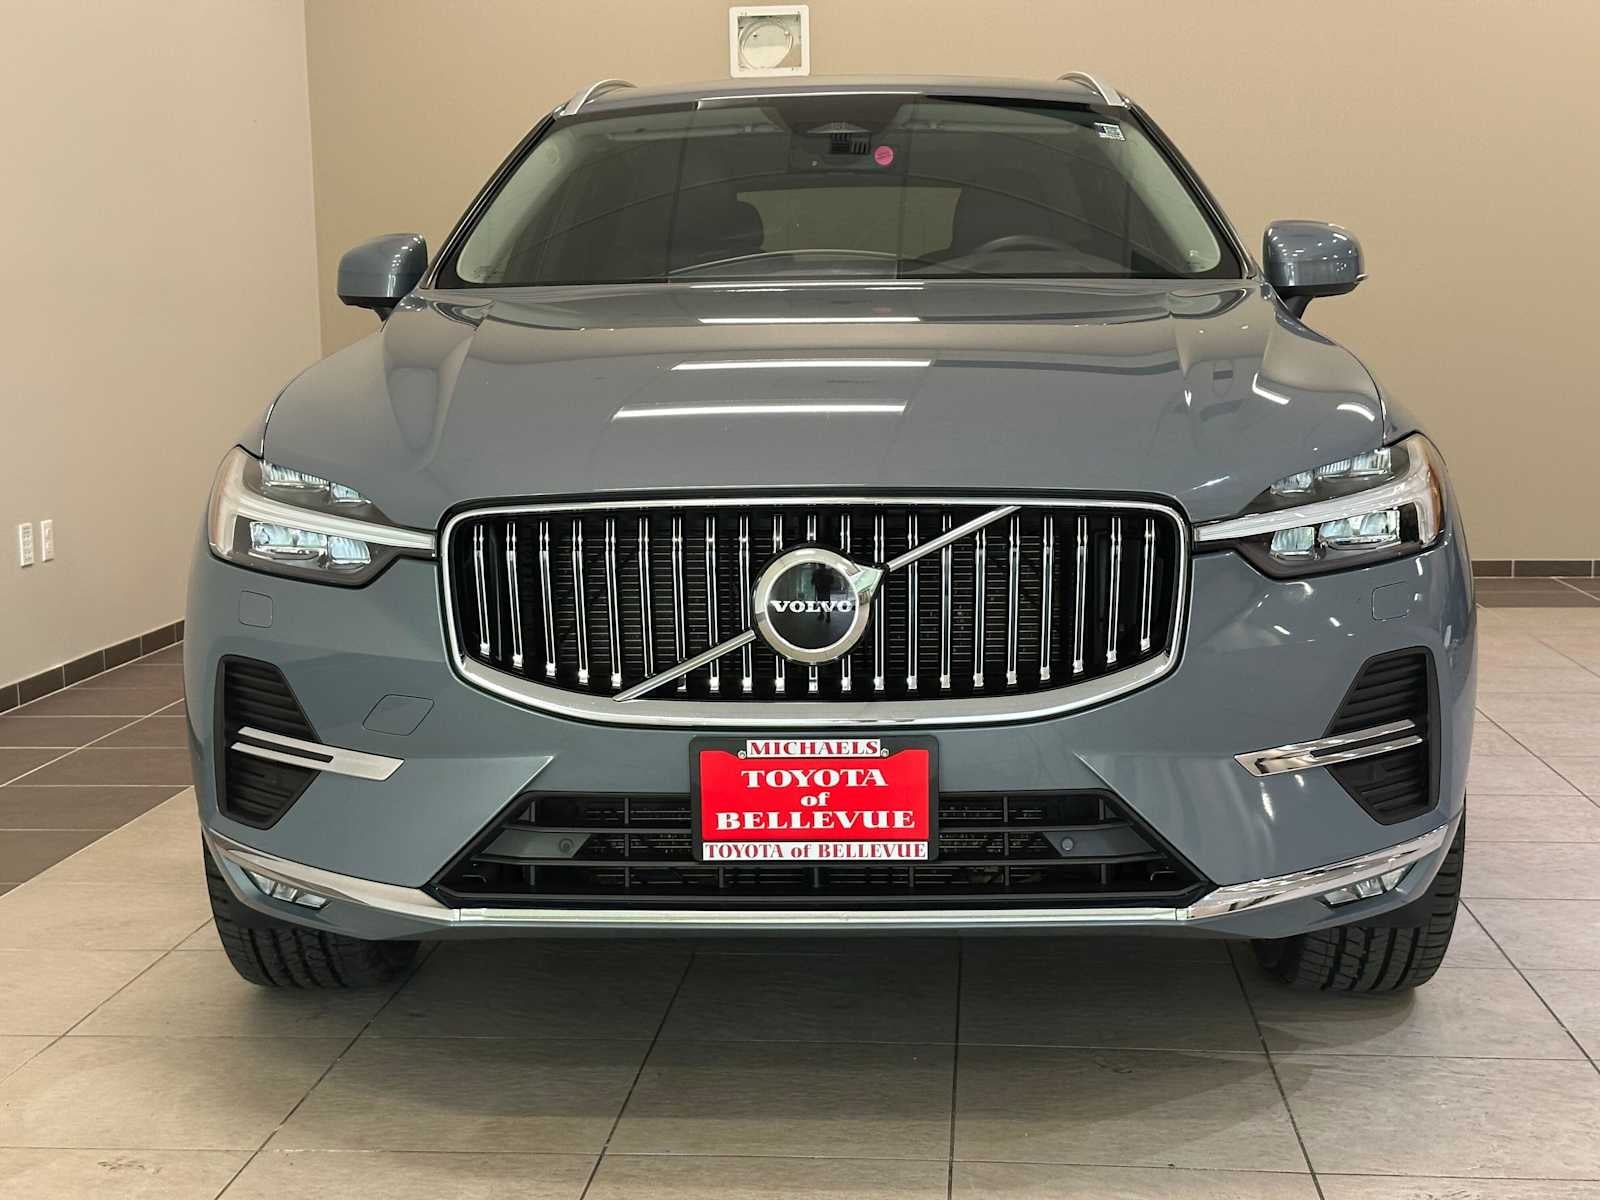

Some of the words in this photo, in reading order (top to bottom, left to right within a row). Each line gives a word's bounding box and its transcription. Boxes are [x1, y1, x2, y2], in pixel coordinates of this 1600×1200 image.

[770, 600, 852, 613] VOLVO
[750, 741, 879, 755] MICHAELS
[741, 768, 888, 788] TOYOTA
[800, 791, 830, 807] of
[715, 810, 917, 831] BELLEVUE
[705, 843, 784, 858] TOYOTA
[790, 843, 810, 858] of
[818, 843, 926, 858] BELLEVUE
